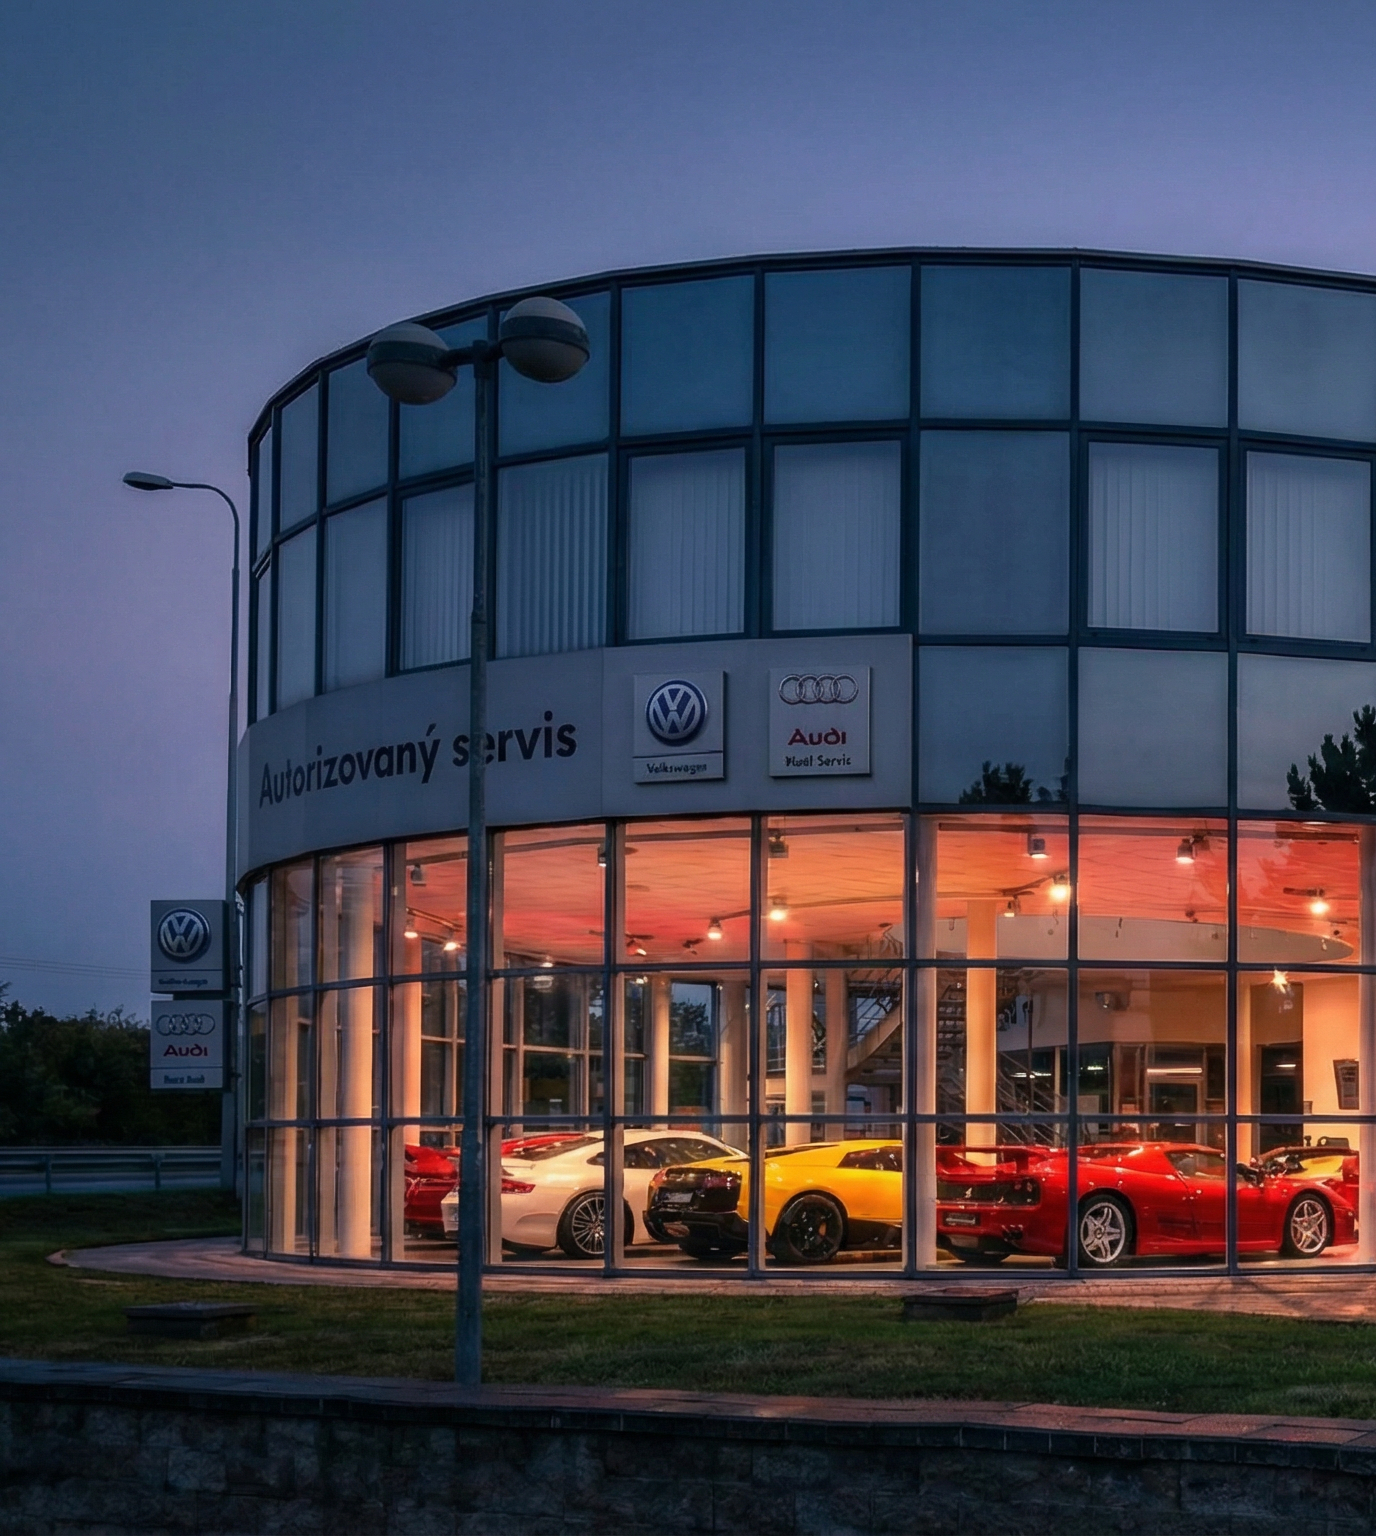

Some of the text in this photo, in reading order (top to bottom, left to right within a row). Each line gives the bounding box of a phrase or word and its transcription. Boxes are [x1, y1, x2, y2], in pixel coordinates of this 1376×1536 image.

[787, 727, 847, 746] Audi
[258, 723, 441, 808] Autorizovaný
[163, 1043, 209, 1057] Audi
